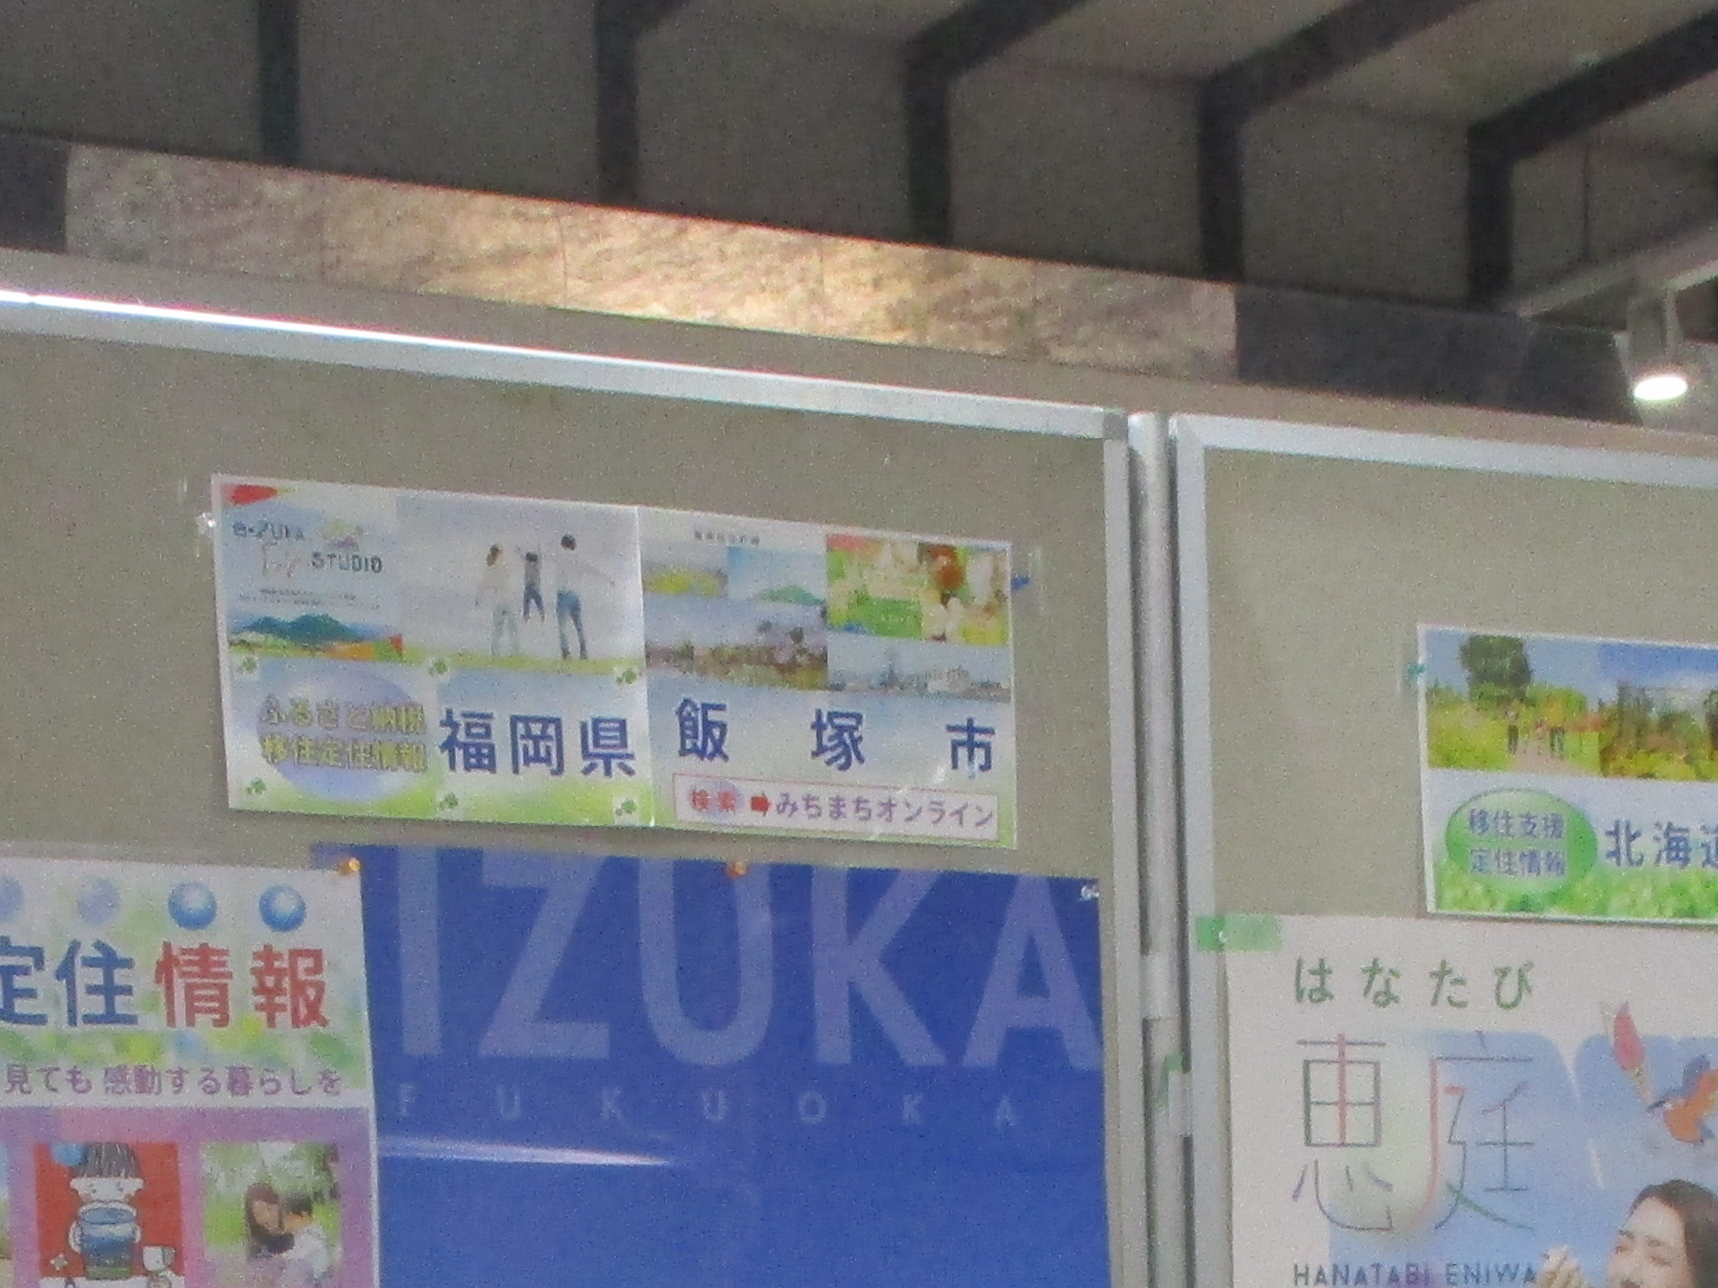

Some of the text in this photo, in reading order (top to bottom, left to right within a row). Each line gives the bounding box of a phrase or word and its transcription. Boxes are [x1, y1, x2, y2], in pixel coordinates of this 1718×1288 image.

[439, 697, 997, 780] 福岡県 飯塚市
[776, 791, 994, 828] みちまちオンライン
[1293, 957, 1536, 1011] はなたび
[397, 1084, 1020, 1130] FUKUOKA
[1292, 1031, 1535, 1233] 恵庭
[1293, 1262, 1538, 1287] HANATABI ENIWA
